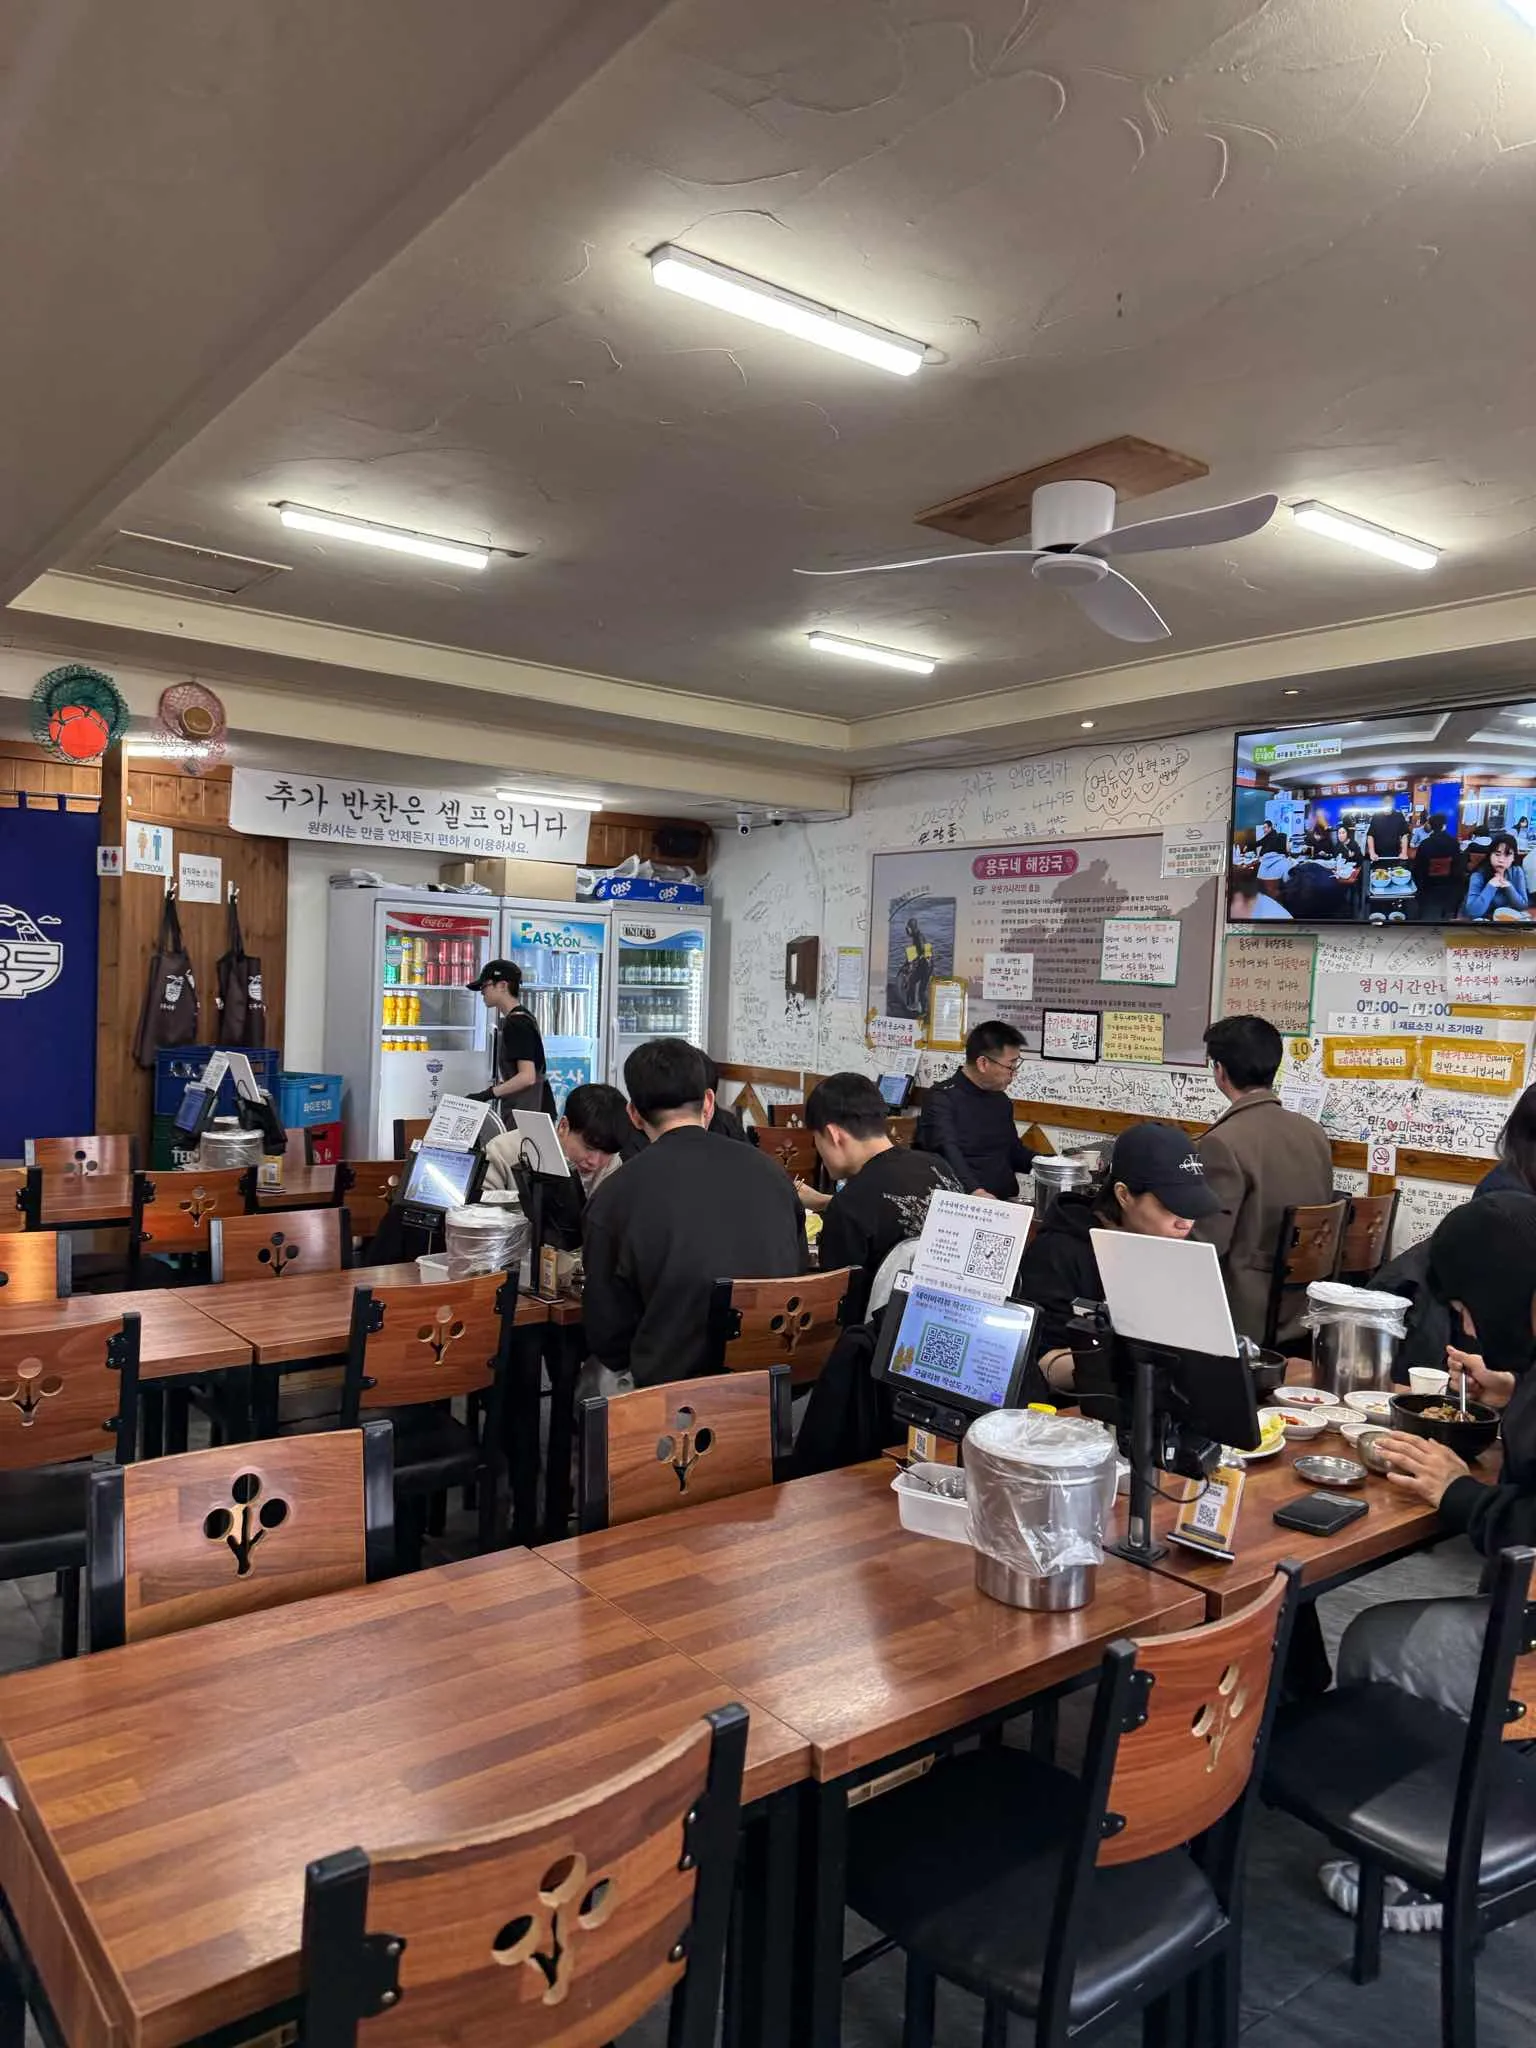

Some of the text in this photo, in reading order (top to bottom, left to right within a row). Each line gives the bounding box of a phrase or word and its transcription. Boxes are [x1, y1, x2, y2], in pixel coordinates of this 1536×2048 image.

[265, 780, 568, 841] 추가 반찬은 셀프입니다
[307, 821, 529, 855] 원하시는 만큼 언제든지 편하게 이용하세요.
[985, 855, 1063, 876] 용두네 해장국
[621, 924, 657, 940] UNIQUE
[1336, 1015, 1484, 1036] 연중무휴 재료소진 시 조기마감
[1293, 1042, 1309, 1056] 10
[1367, 1115, 1387, 1134] 민주
[899, 1275, 909, 1289] 5
[915, 1291, 954, 1309] 네이버리뷰
[912, 1368, 941, 1384] 구글리뷰
